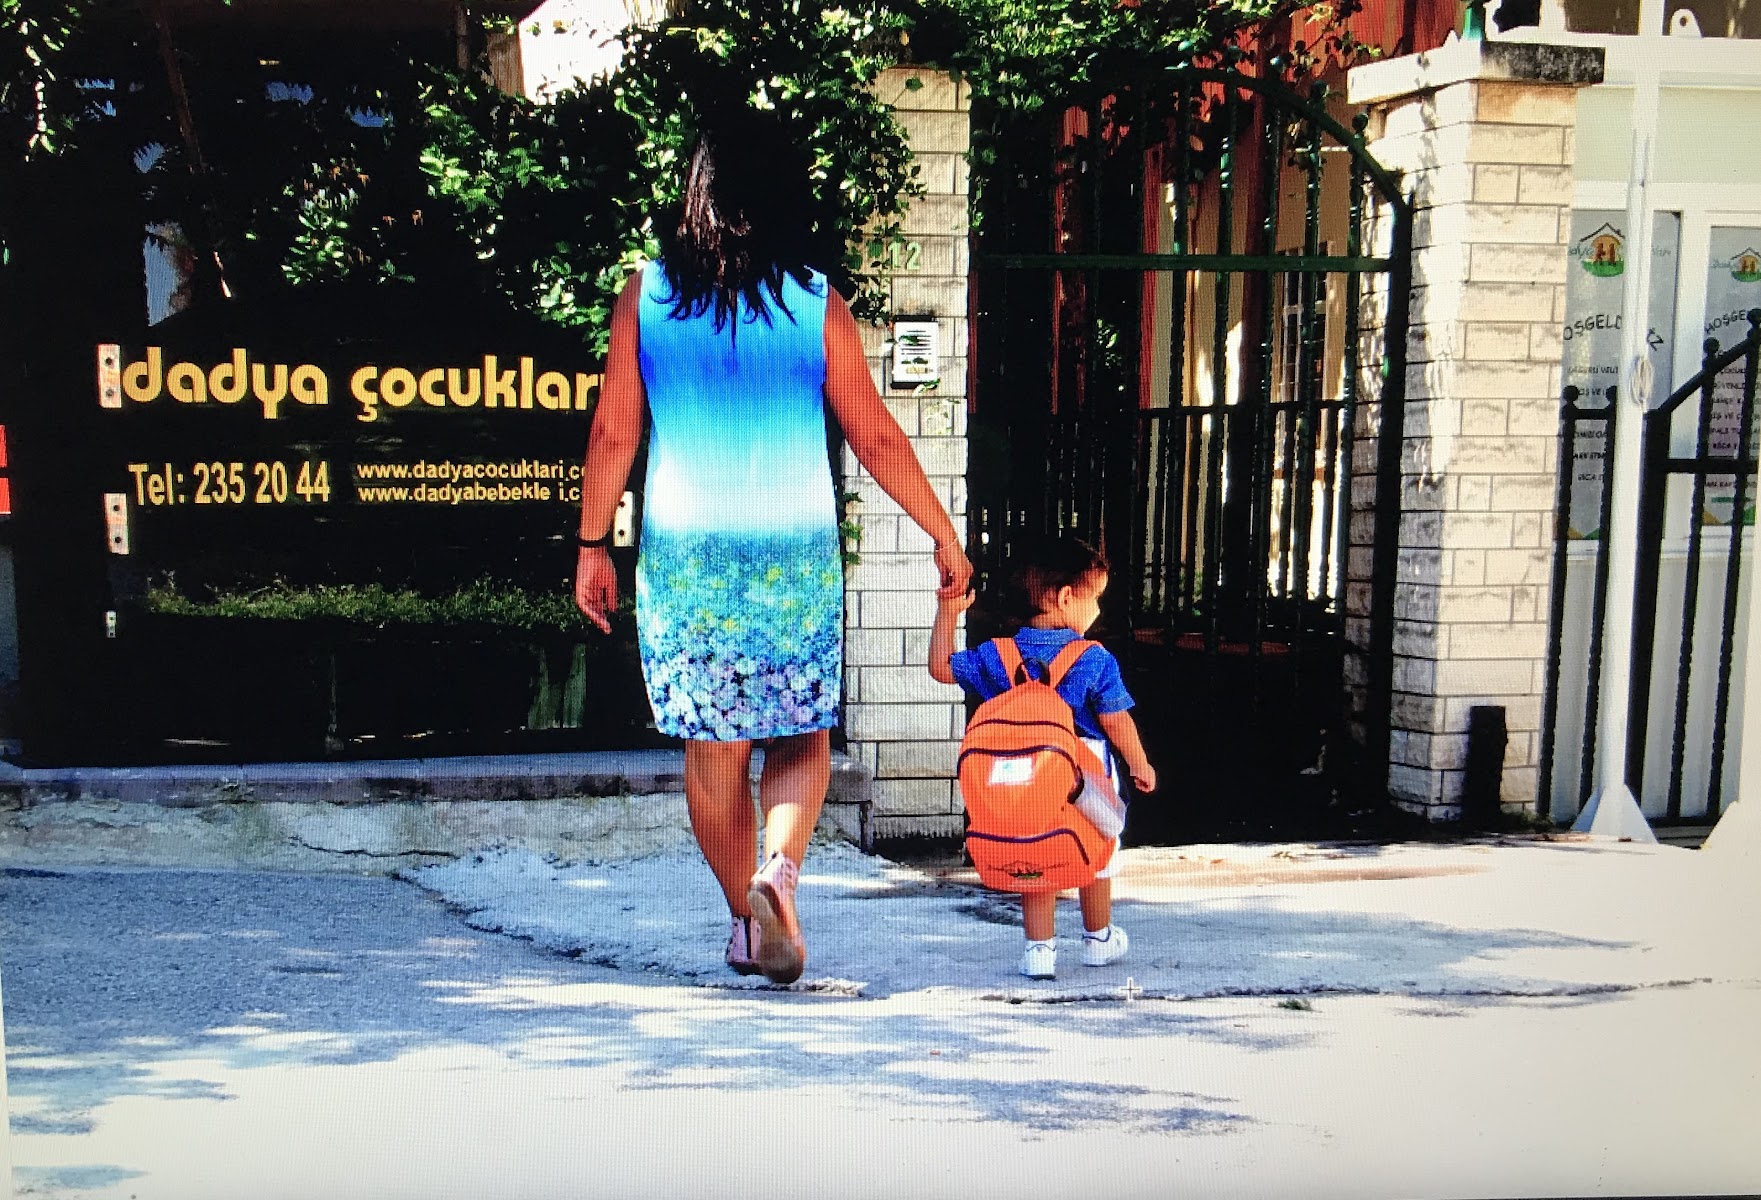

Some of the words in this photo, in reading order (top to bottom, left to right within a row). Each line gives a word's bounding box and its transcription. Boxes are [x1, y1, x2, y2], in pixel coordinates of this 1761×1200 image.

[888, 241, 922, 270] 12
[122, 346, 329, 419] dadya
[128, 462, 185, 506] Tel:
[193, 461, 246, 504] 235
[253, 461, 288, 504] 20
[296, 460, 331, 503] 44
